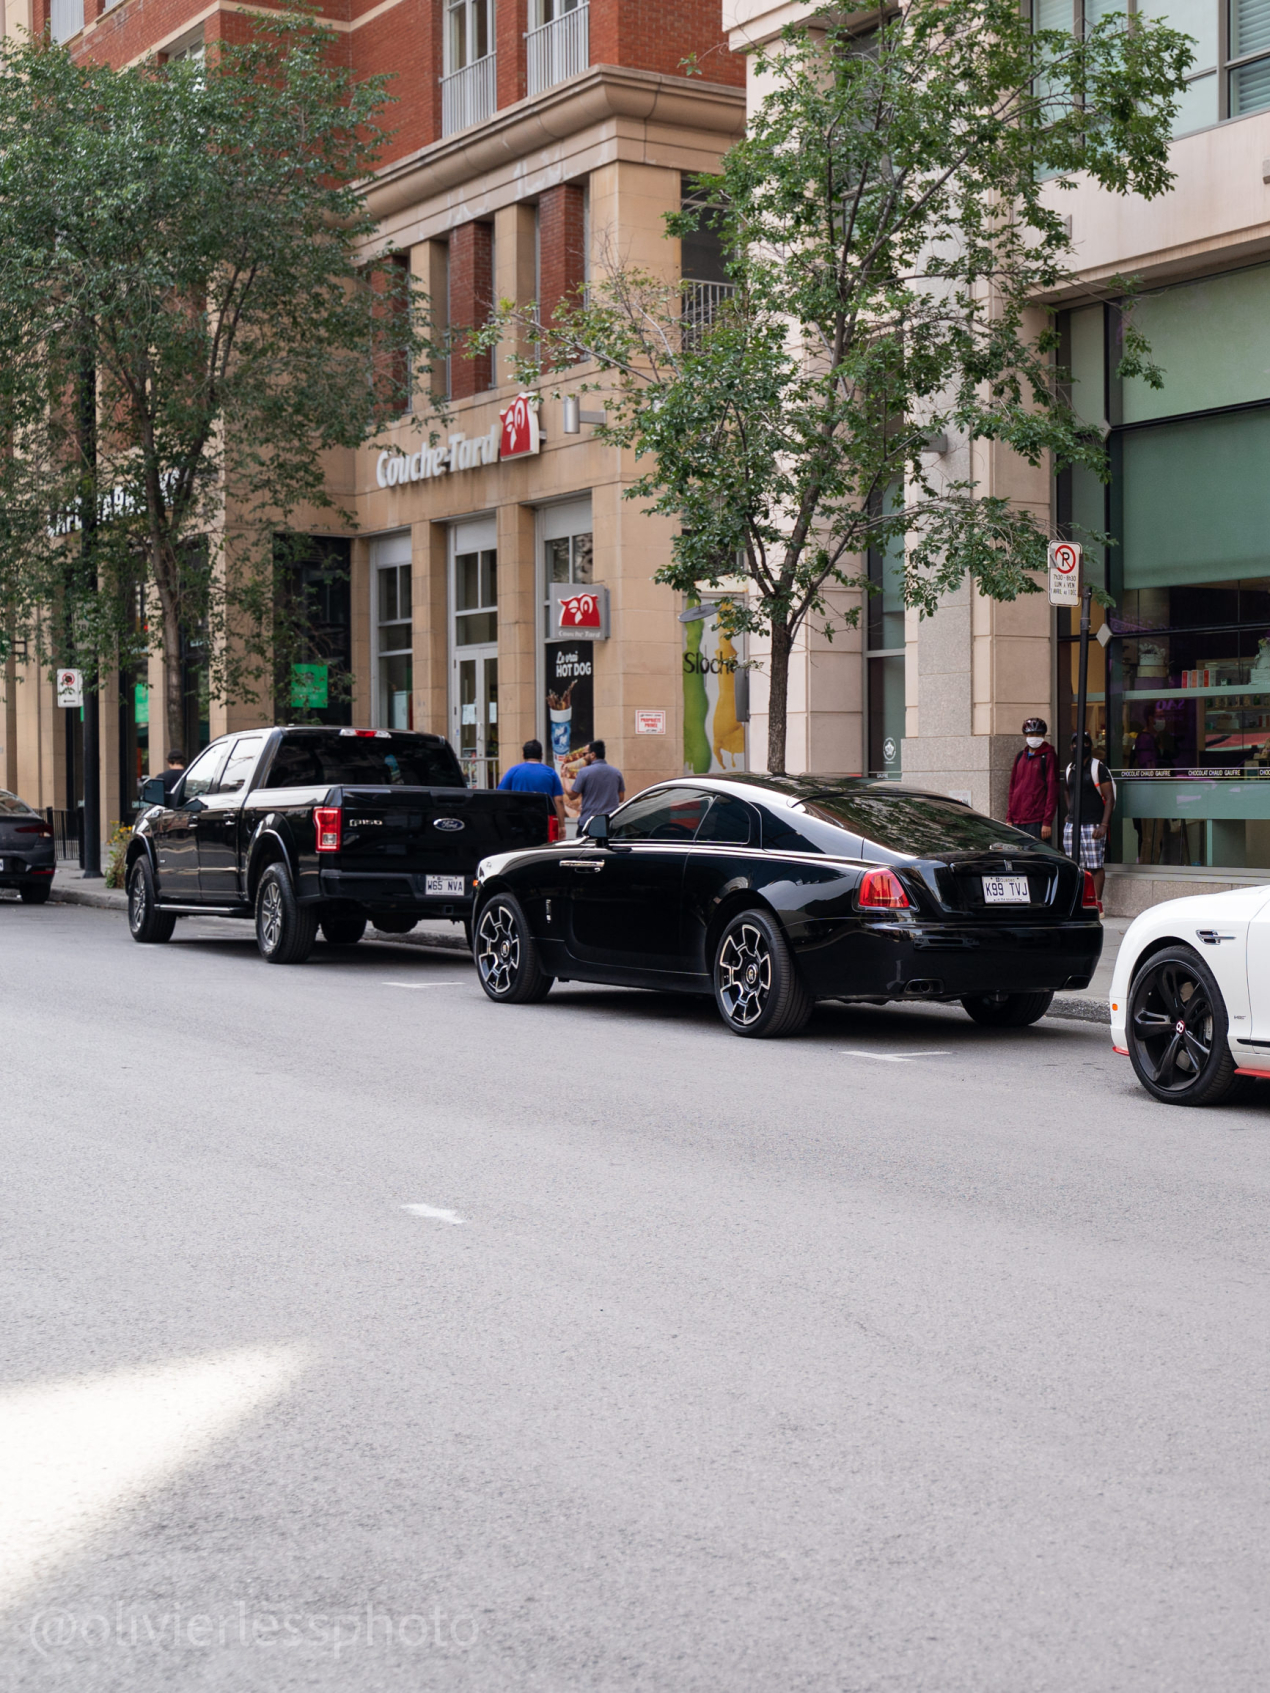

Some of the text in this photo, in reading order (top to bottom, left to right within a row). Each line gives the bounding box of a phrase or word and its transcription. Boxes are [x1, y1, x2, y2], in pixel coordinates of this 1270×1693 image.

[376, 424, 500, 488] Couche-Tard
[556, 662, 592, 678] HOT DOG
[683, 651, 740, 676] Sloche
[427, 880, 463, 892] W65 NVA
[985, 882, 1028, 897] K99 TVJ
